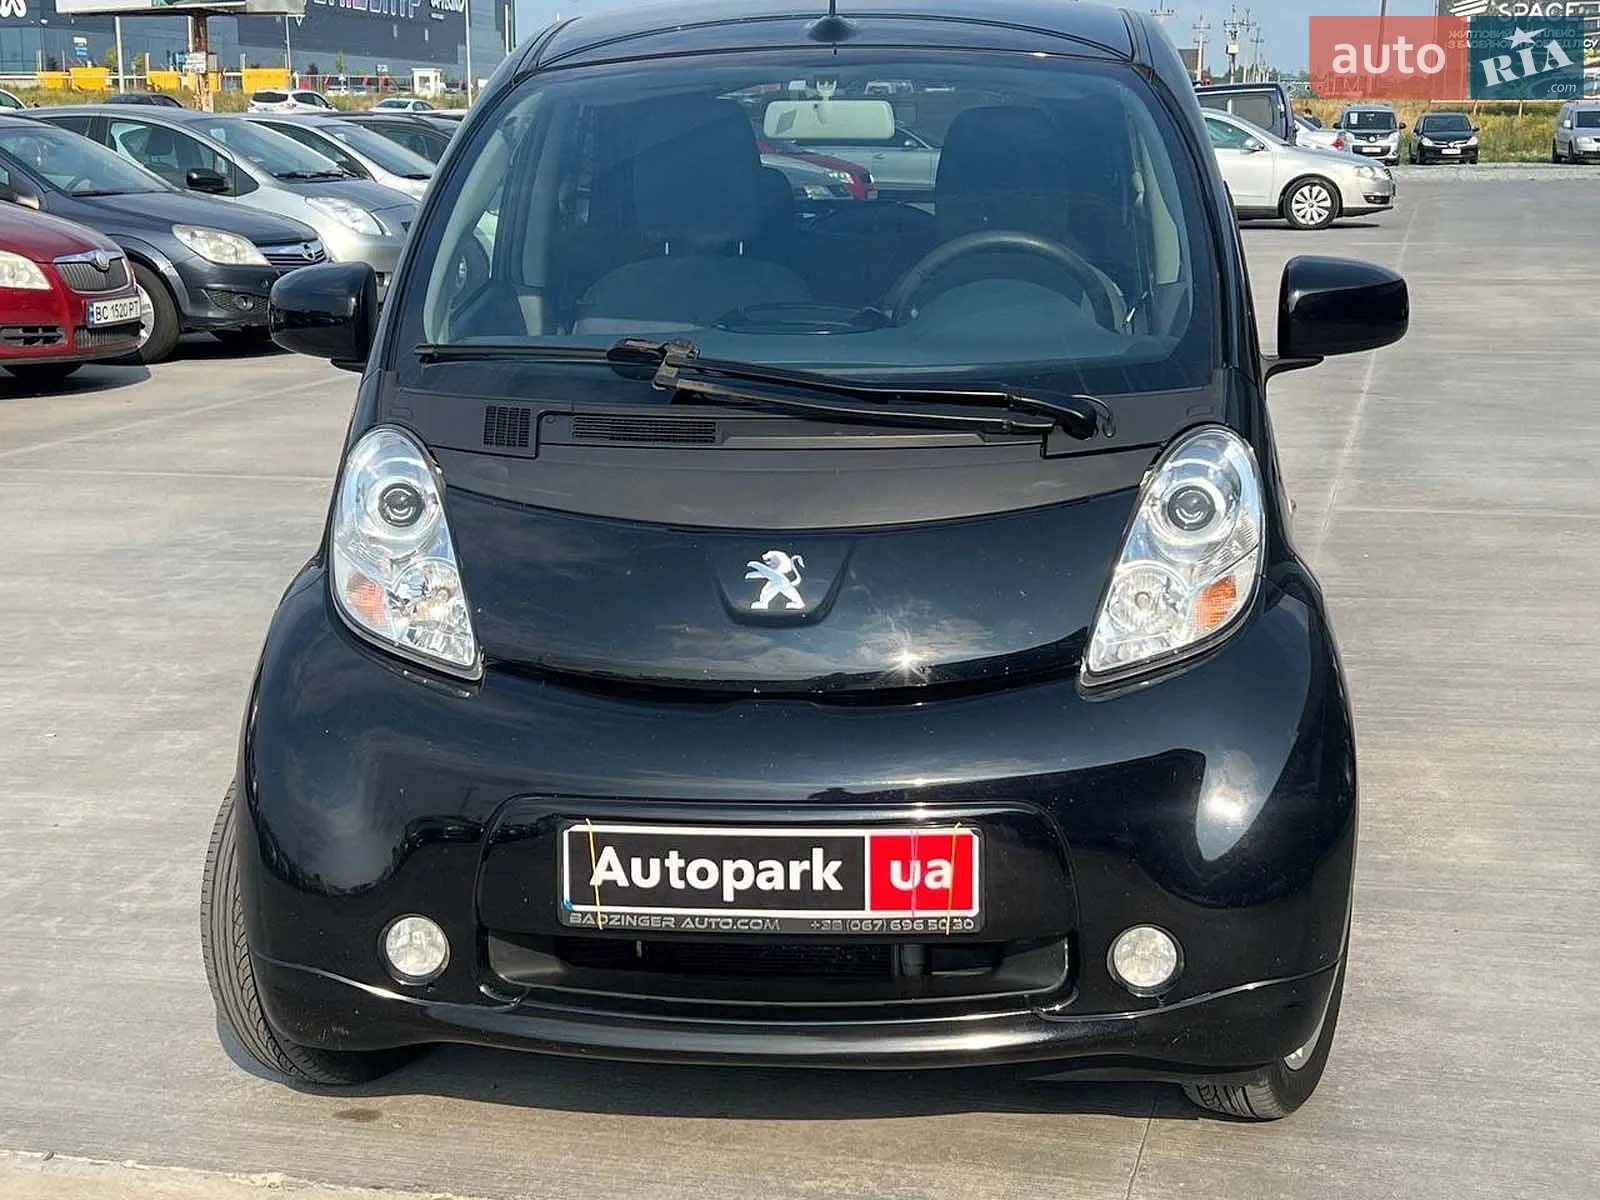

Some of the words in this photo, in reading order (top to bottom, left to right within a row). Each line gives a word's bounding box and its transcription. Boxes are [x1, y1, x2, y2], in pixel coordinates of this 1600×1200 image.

[590, 845, 844, 902] Autopark
[889, 857, 953, 890] ua
[681, 917, 781, 932] AUTO.COM
[890, 919, 924, 931] 696
